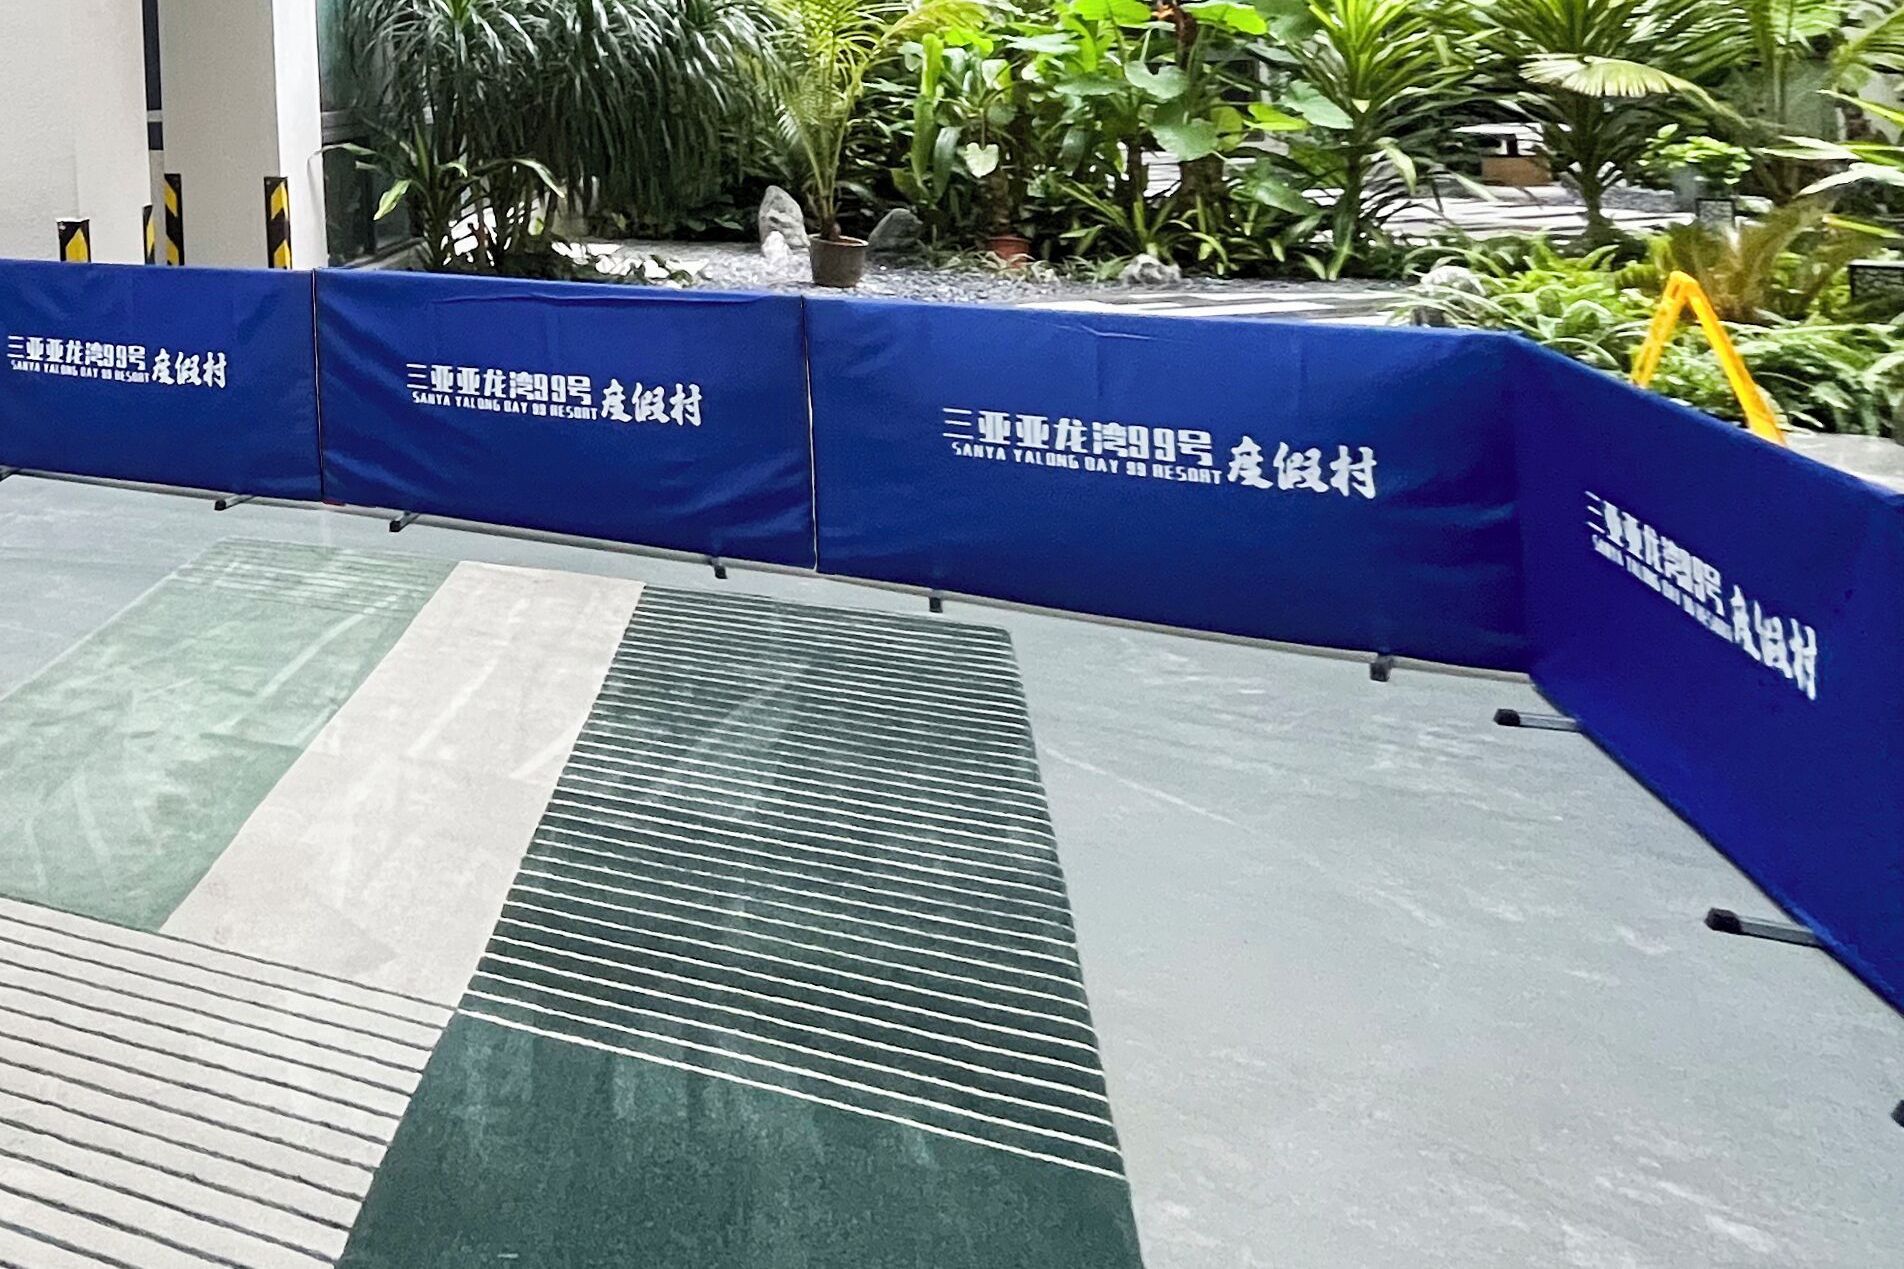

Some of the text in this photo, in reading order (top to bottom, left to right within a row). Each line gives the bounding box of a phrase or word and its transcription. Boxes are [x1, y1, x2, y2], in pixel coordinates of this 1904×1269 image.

[951, 441, 1006, 461] SANYA
[1013, 449, 1079, 470] YALONG
[1084, 456, 1118, 474] BAY
[1152, 463, 1222, 485] RESORT
